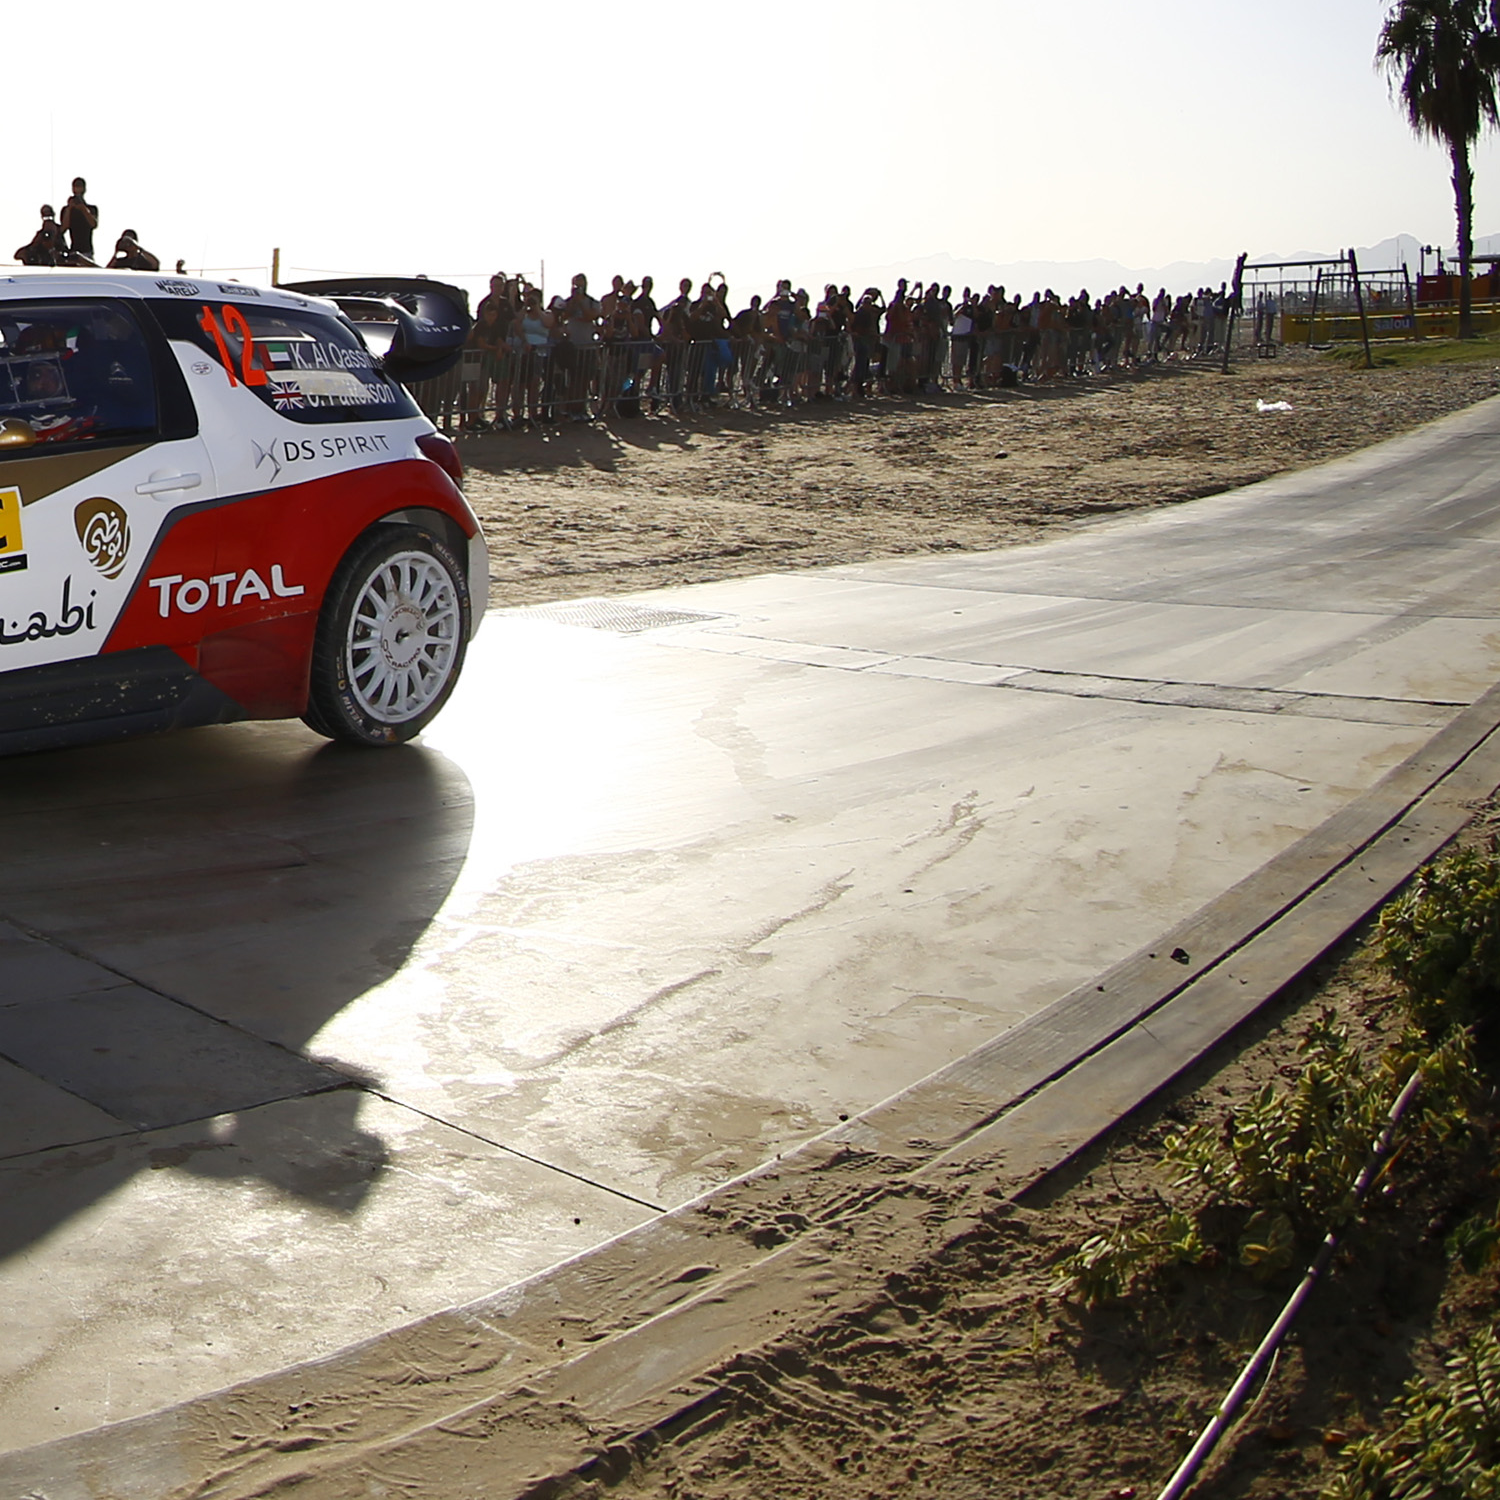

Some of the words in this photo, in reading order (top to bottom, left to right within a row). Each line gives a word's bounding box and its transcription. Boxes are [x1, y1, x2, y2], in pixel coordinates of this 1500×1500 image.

[199, 303, 268, 389] 12
[290, 342, 313, 369] K.
[315, 342, 331, 369] Al
[282, 439, 317, 463] DS
[322, 434, 391, 459] SPIRIT
[148, 563, 305, 619] TOTAL
